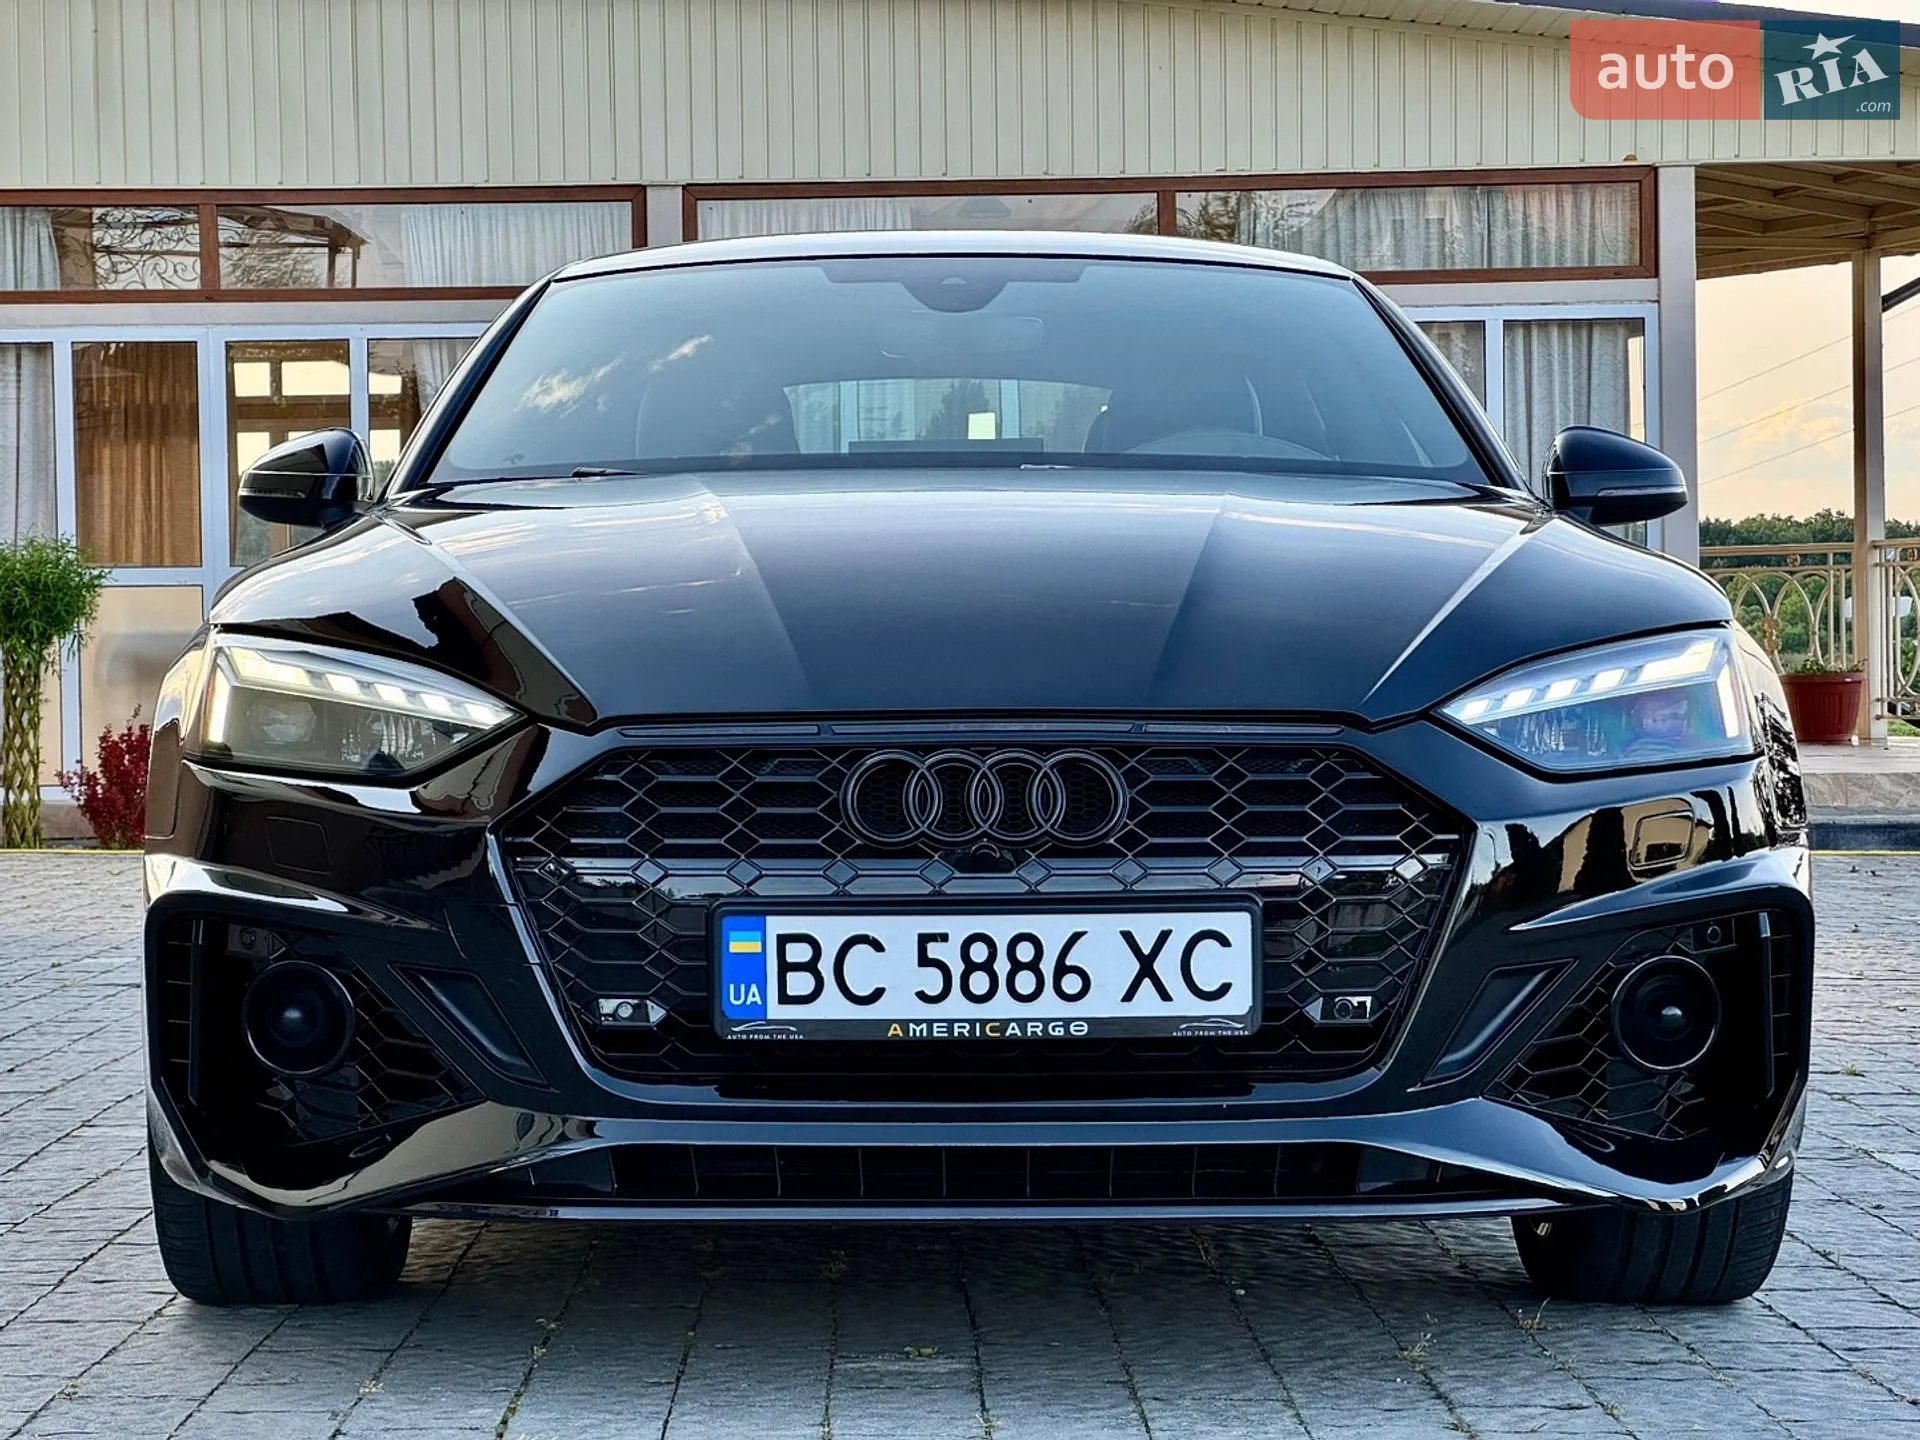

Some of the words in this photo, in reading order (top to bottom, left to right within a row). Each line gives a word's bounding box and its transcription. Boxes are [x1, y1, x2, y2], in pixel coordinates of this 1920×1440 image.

[776, 933, 887, 1007] BC
[915, 931, 1092, 1005] 5886
[1119, 929, 1234, 1003] XC
[729, 983, 763, 1006] UA
[887, 1021, 1090, 1038] AMERICARGO
